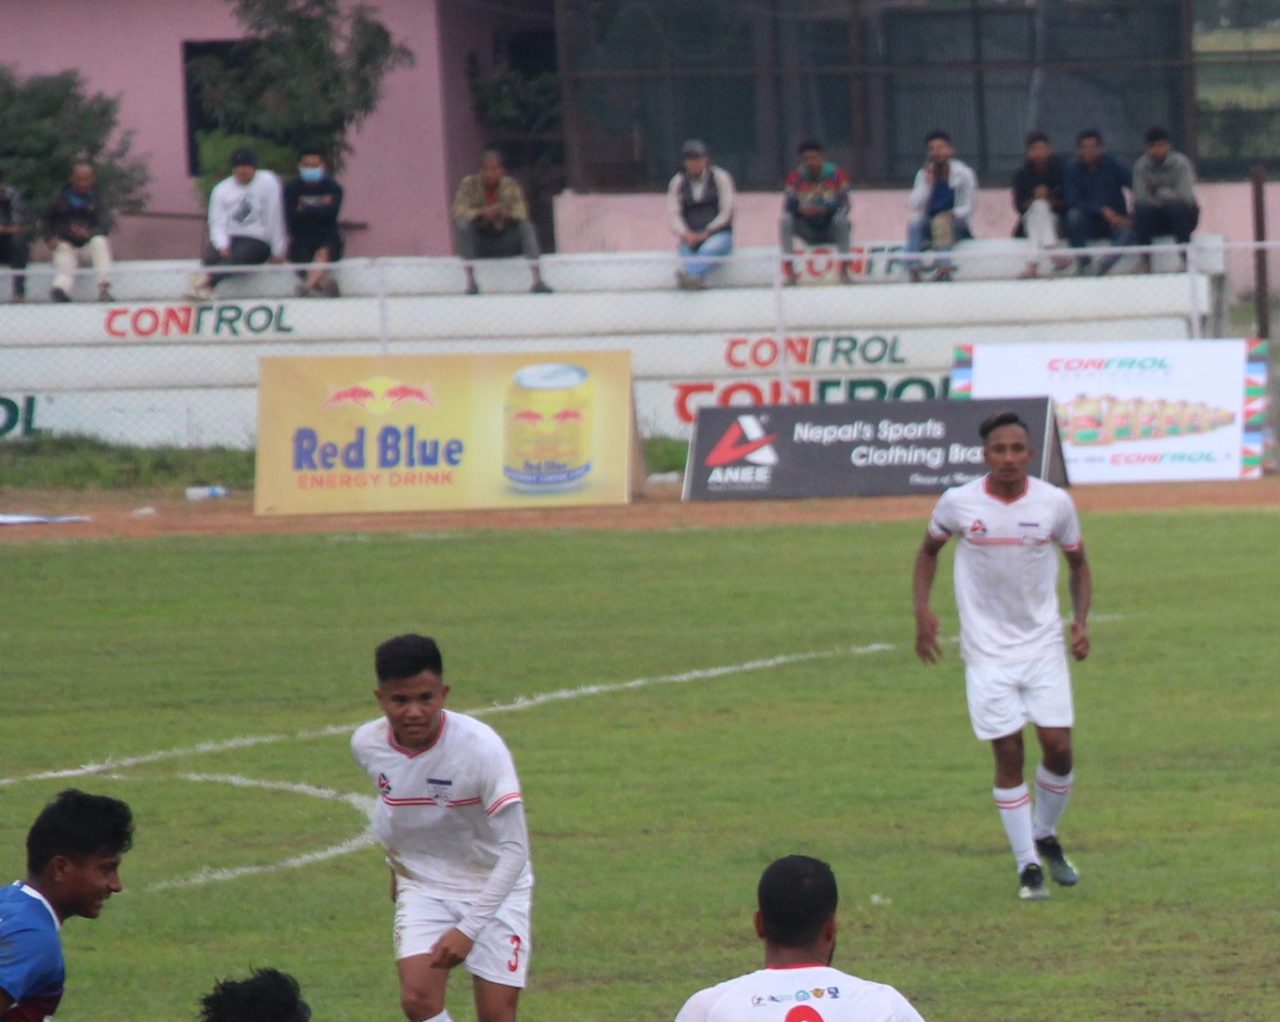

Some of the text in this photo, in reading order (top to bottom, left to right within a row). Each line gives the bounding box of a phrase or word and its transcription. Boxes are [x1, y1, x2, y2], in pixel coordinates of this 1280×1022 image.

[105, 305, 292, 337] CONTROL
[724, 335, 906, 369] CONTROL
[1047, 357, 1170, 372] CONTROL
[794, 418, 946, 444] Nepal's Sports
[293, 426, 465, 471] Red Blue
[851, 443, 985, 468] Clothing Bra
[297, 471, 455, 490] ENERGY DRINK
[707, 467, 771, 483] ANEE
[507, 934, 523, 972] 3
